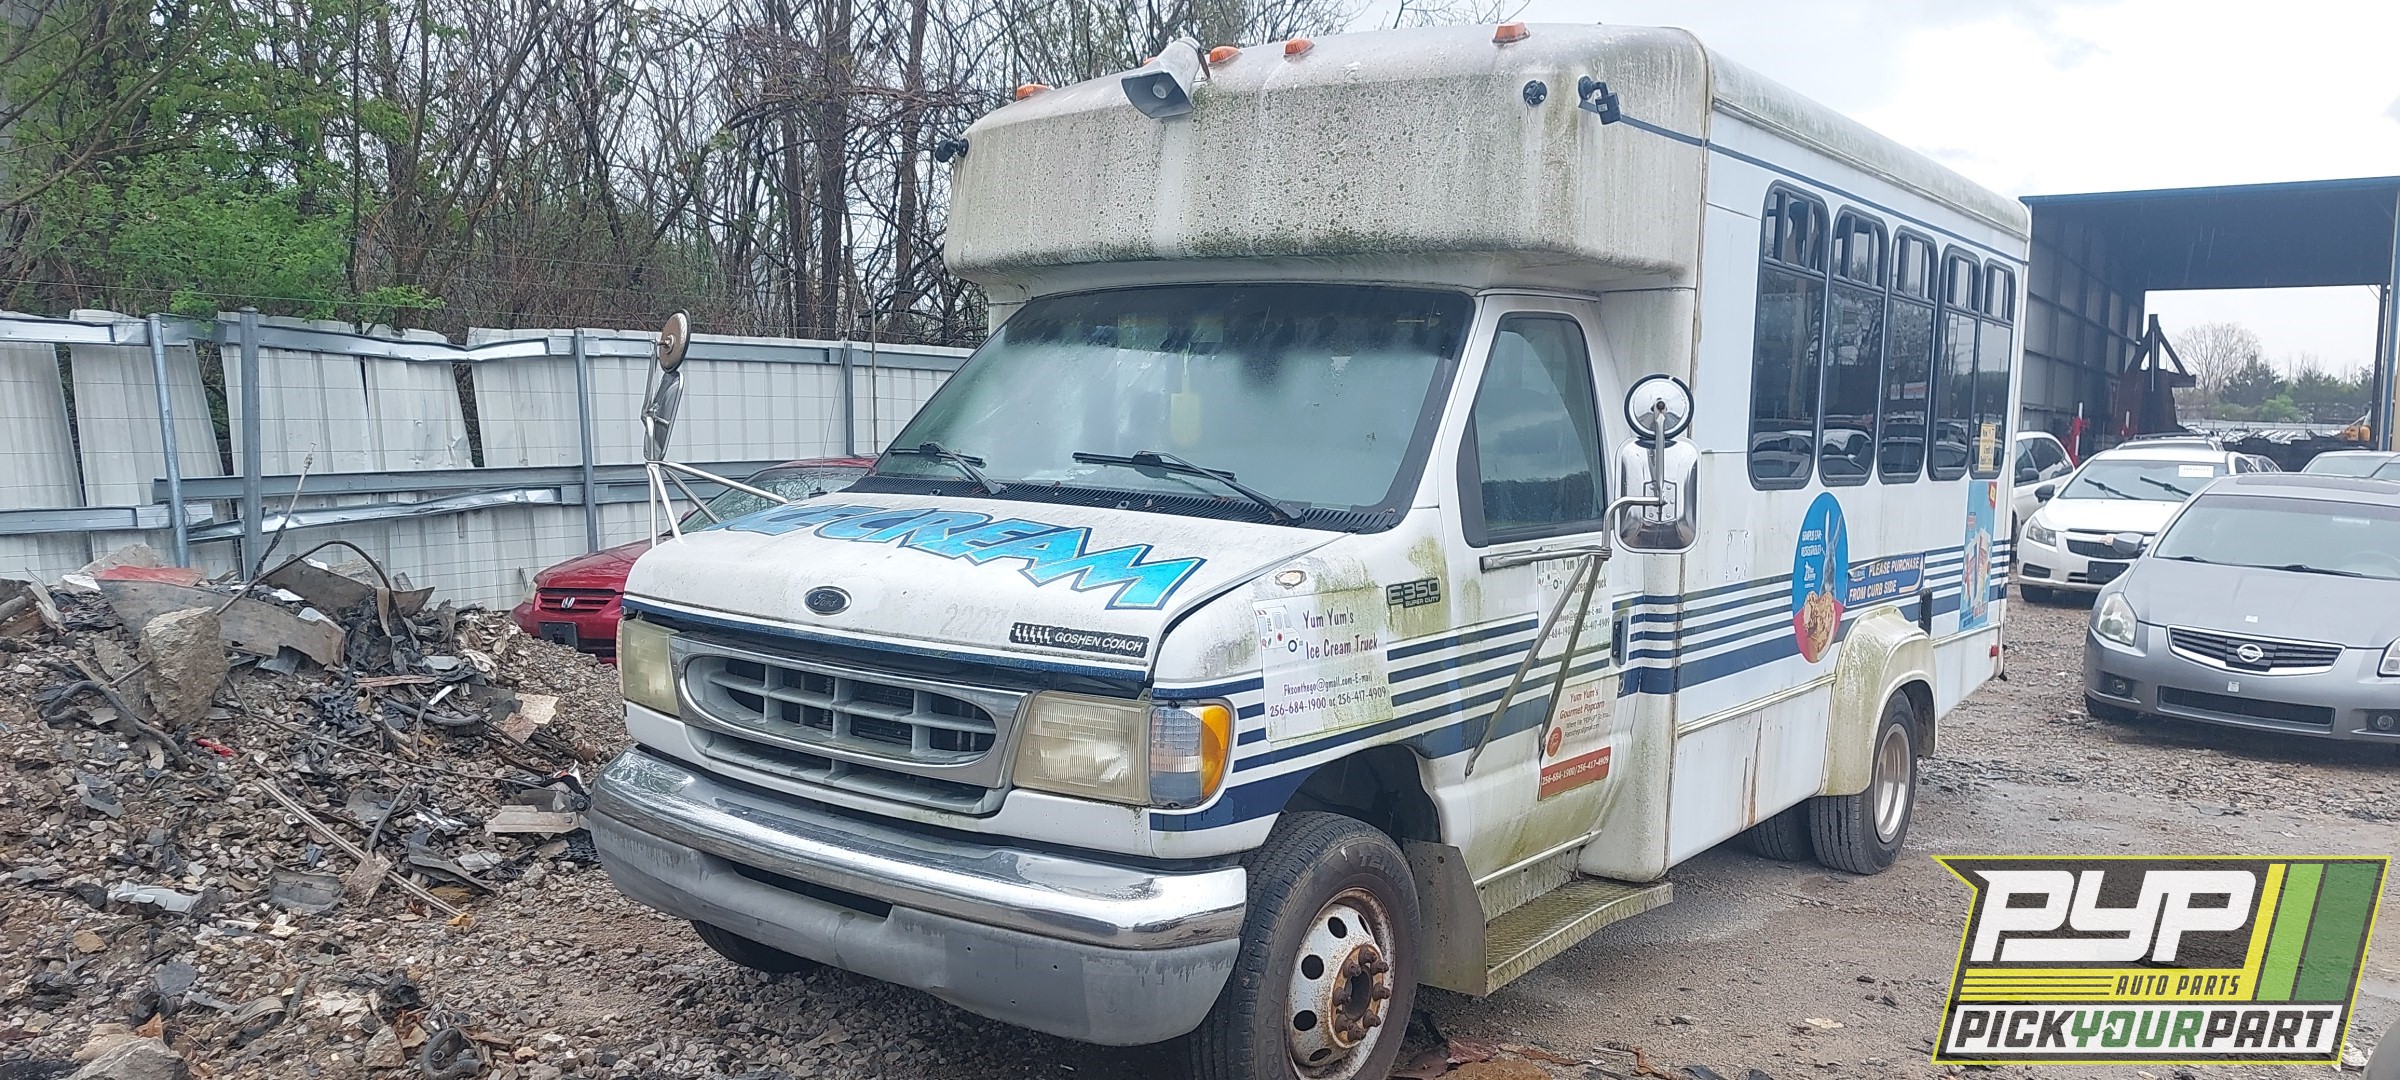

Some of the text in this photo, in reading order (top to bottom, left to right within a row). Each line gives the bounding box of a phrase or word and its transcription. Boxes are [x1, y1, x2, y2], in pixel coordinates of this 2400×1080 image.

[813, 508, 1207, 611] CREAM
[1868, 560, 1891, 577] PLEASE
[1891, 556, 1920, 573] PURCHASE
[1405, 595, 1440, 607] SUPER DUTY
[1848, 580, 1898, 602] FROM CURB SIDE
[1302, 606, 1355, 629] Yum Yum's
[1054, 632, 1144, 652] GOSHEN COACH
[1305, 632, 1378, 660] Ice Cream Truck
[1269, 697, 1327, 717] 256-684-1900
[1337, 686, 1388, 706] 256-417-4909
[1569, 686, 1599, 703] Yum Yum's
[1559, 700, 1606, 720] Gourmet Popcorn
